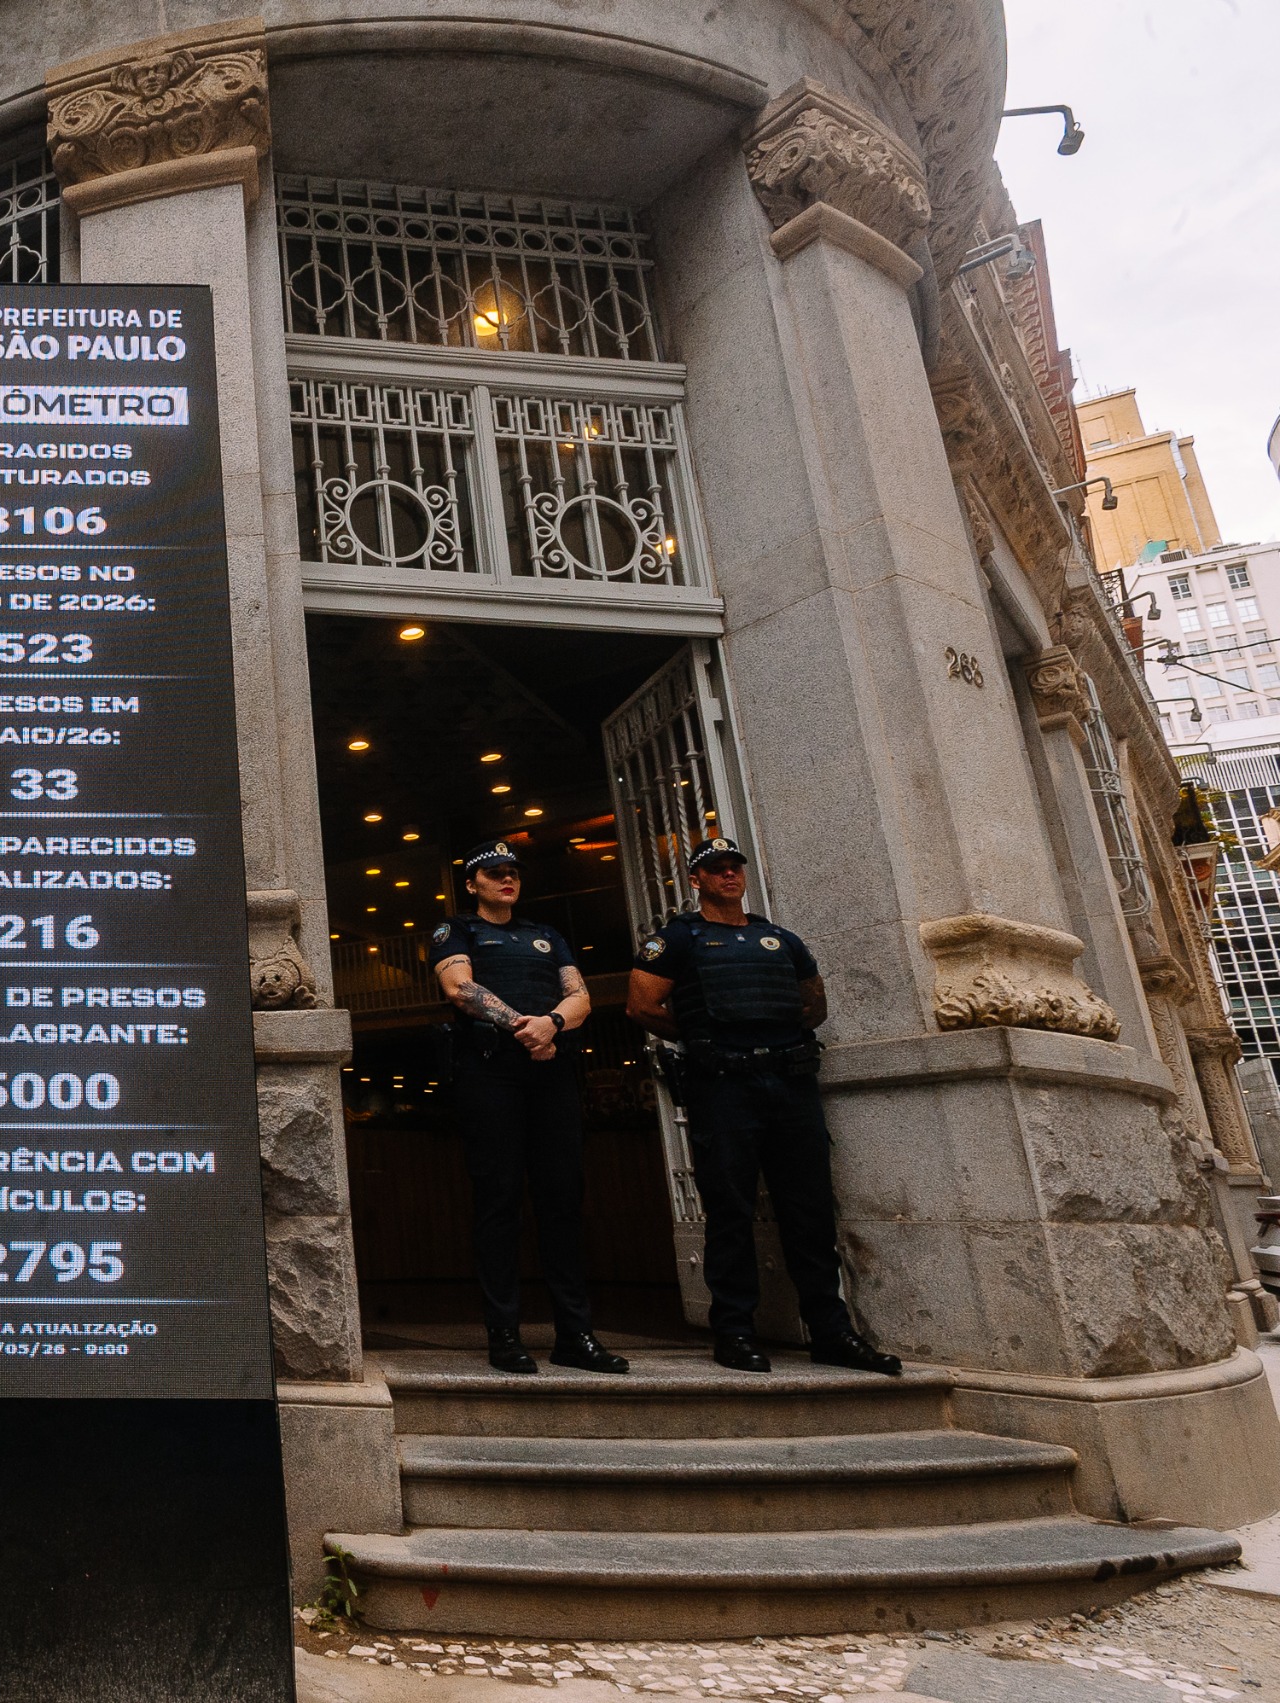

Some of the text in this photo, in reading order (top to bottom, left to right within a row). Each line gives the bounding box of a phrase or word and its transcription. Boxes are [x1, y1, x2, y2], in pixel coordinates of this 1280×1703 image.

[149, 309, 183, 328] DE
[67, 335, 186, 362] PAULO
[89, 565, 135, 582] NO
[9, 593, 53, 611] DE
[58, 593, 157, 612] 2026:
[944, 646, 984, 689] 268
[91, 696, 140, 714] EM
[10, 768, 80, 801] 33
[6, 986, 53, 1008] DE
[61, 986, 207, 1008] PRESOS
[131, 1151, 216, 1173] COM
[21, 1320, 158, 1338] ATUALIZAÇÃO
